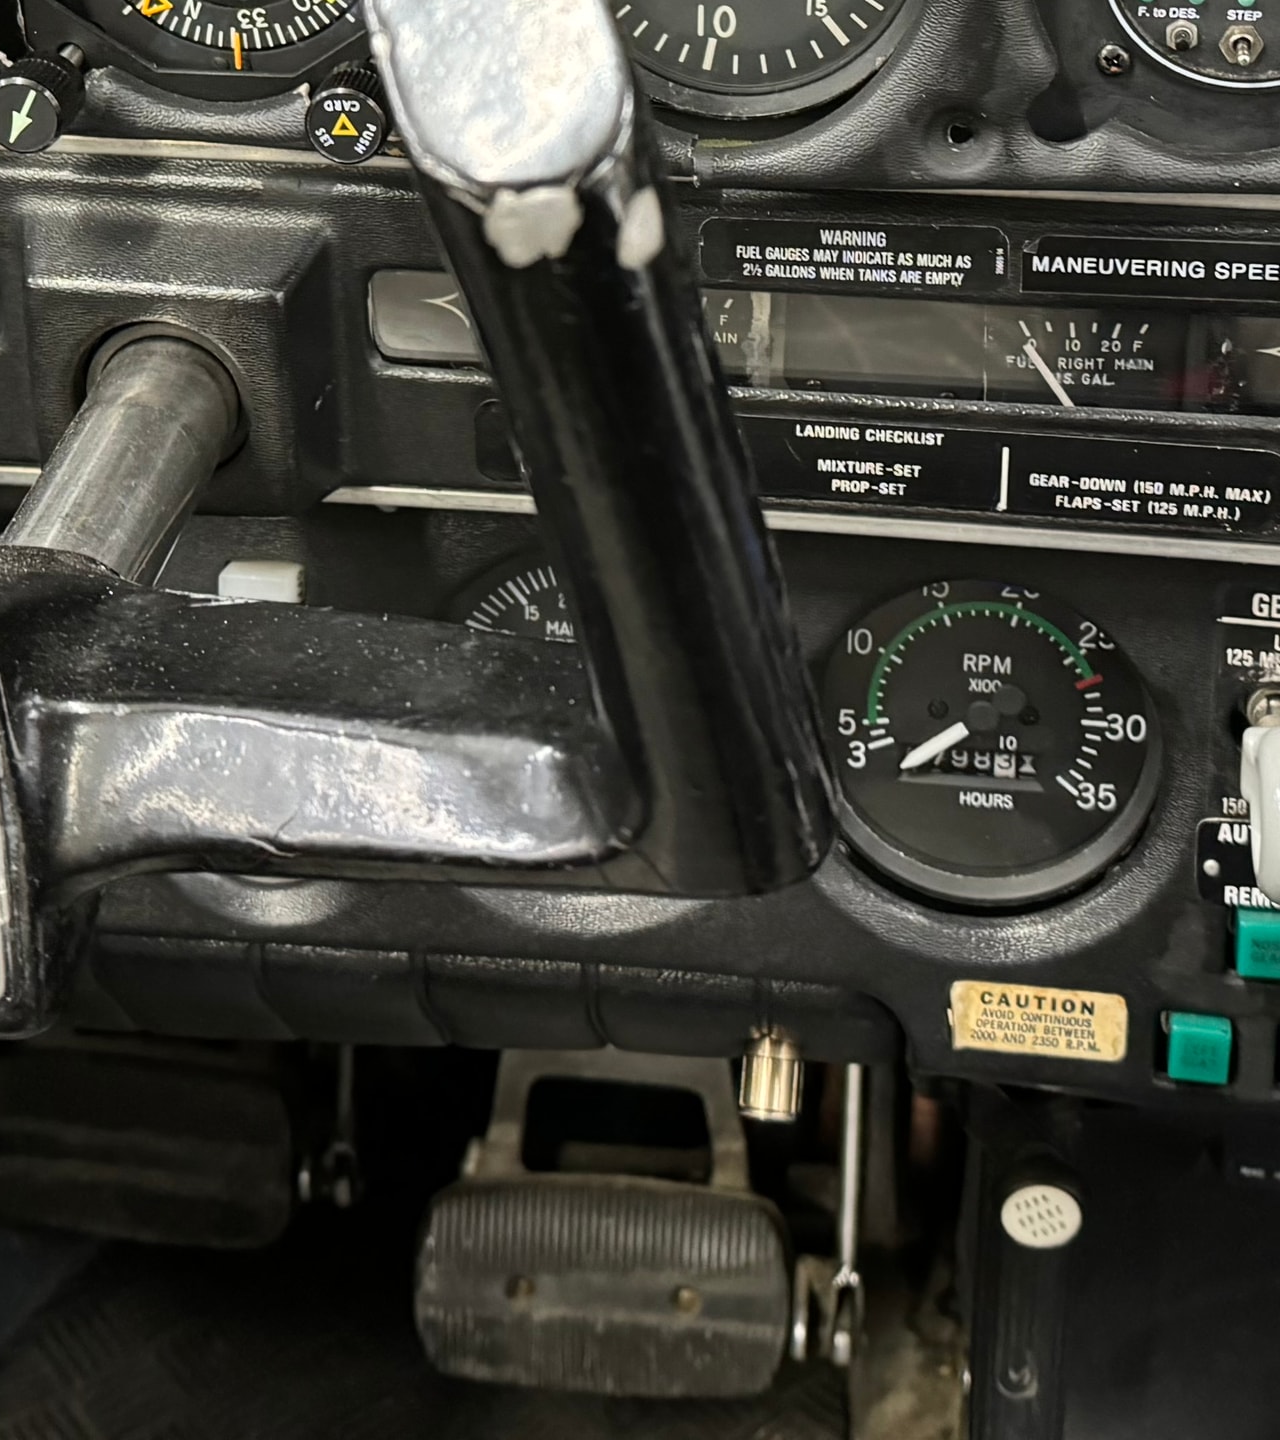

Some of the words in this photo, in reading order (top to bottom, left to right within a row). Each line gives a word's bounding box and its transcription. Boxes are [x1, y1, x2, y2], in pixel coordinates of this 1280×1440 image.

[1226, 10, 1263, 22] STEP
[819, 228, 888, 248] WARNING
[1031, 255, 1206, 280] MANEUVERING
[795, 423, 861, 441] LANDING
[865, 428, 945, 447] CHECKLIST
[817, 458, 922, 478] MIXTURE-SET
[831, 479, 907, 496] PROP-SET
[963, 653, 1012, 675] RPM
[958, 790, 1015, 810] HOURS
[979, 990, 1096, 1017] CAUTION
